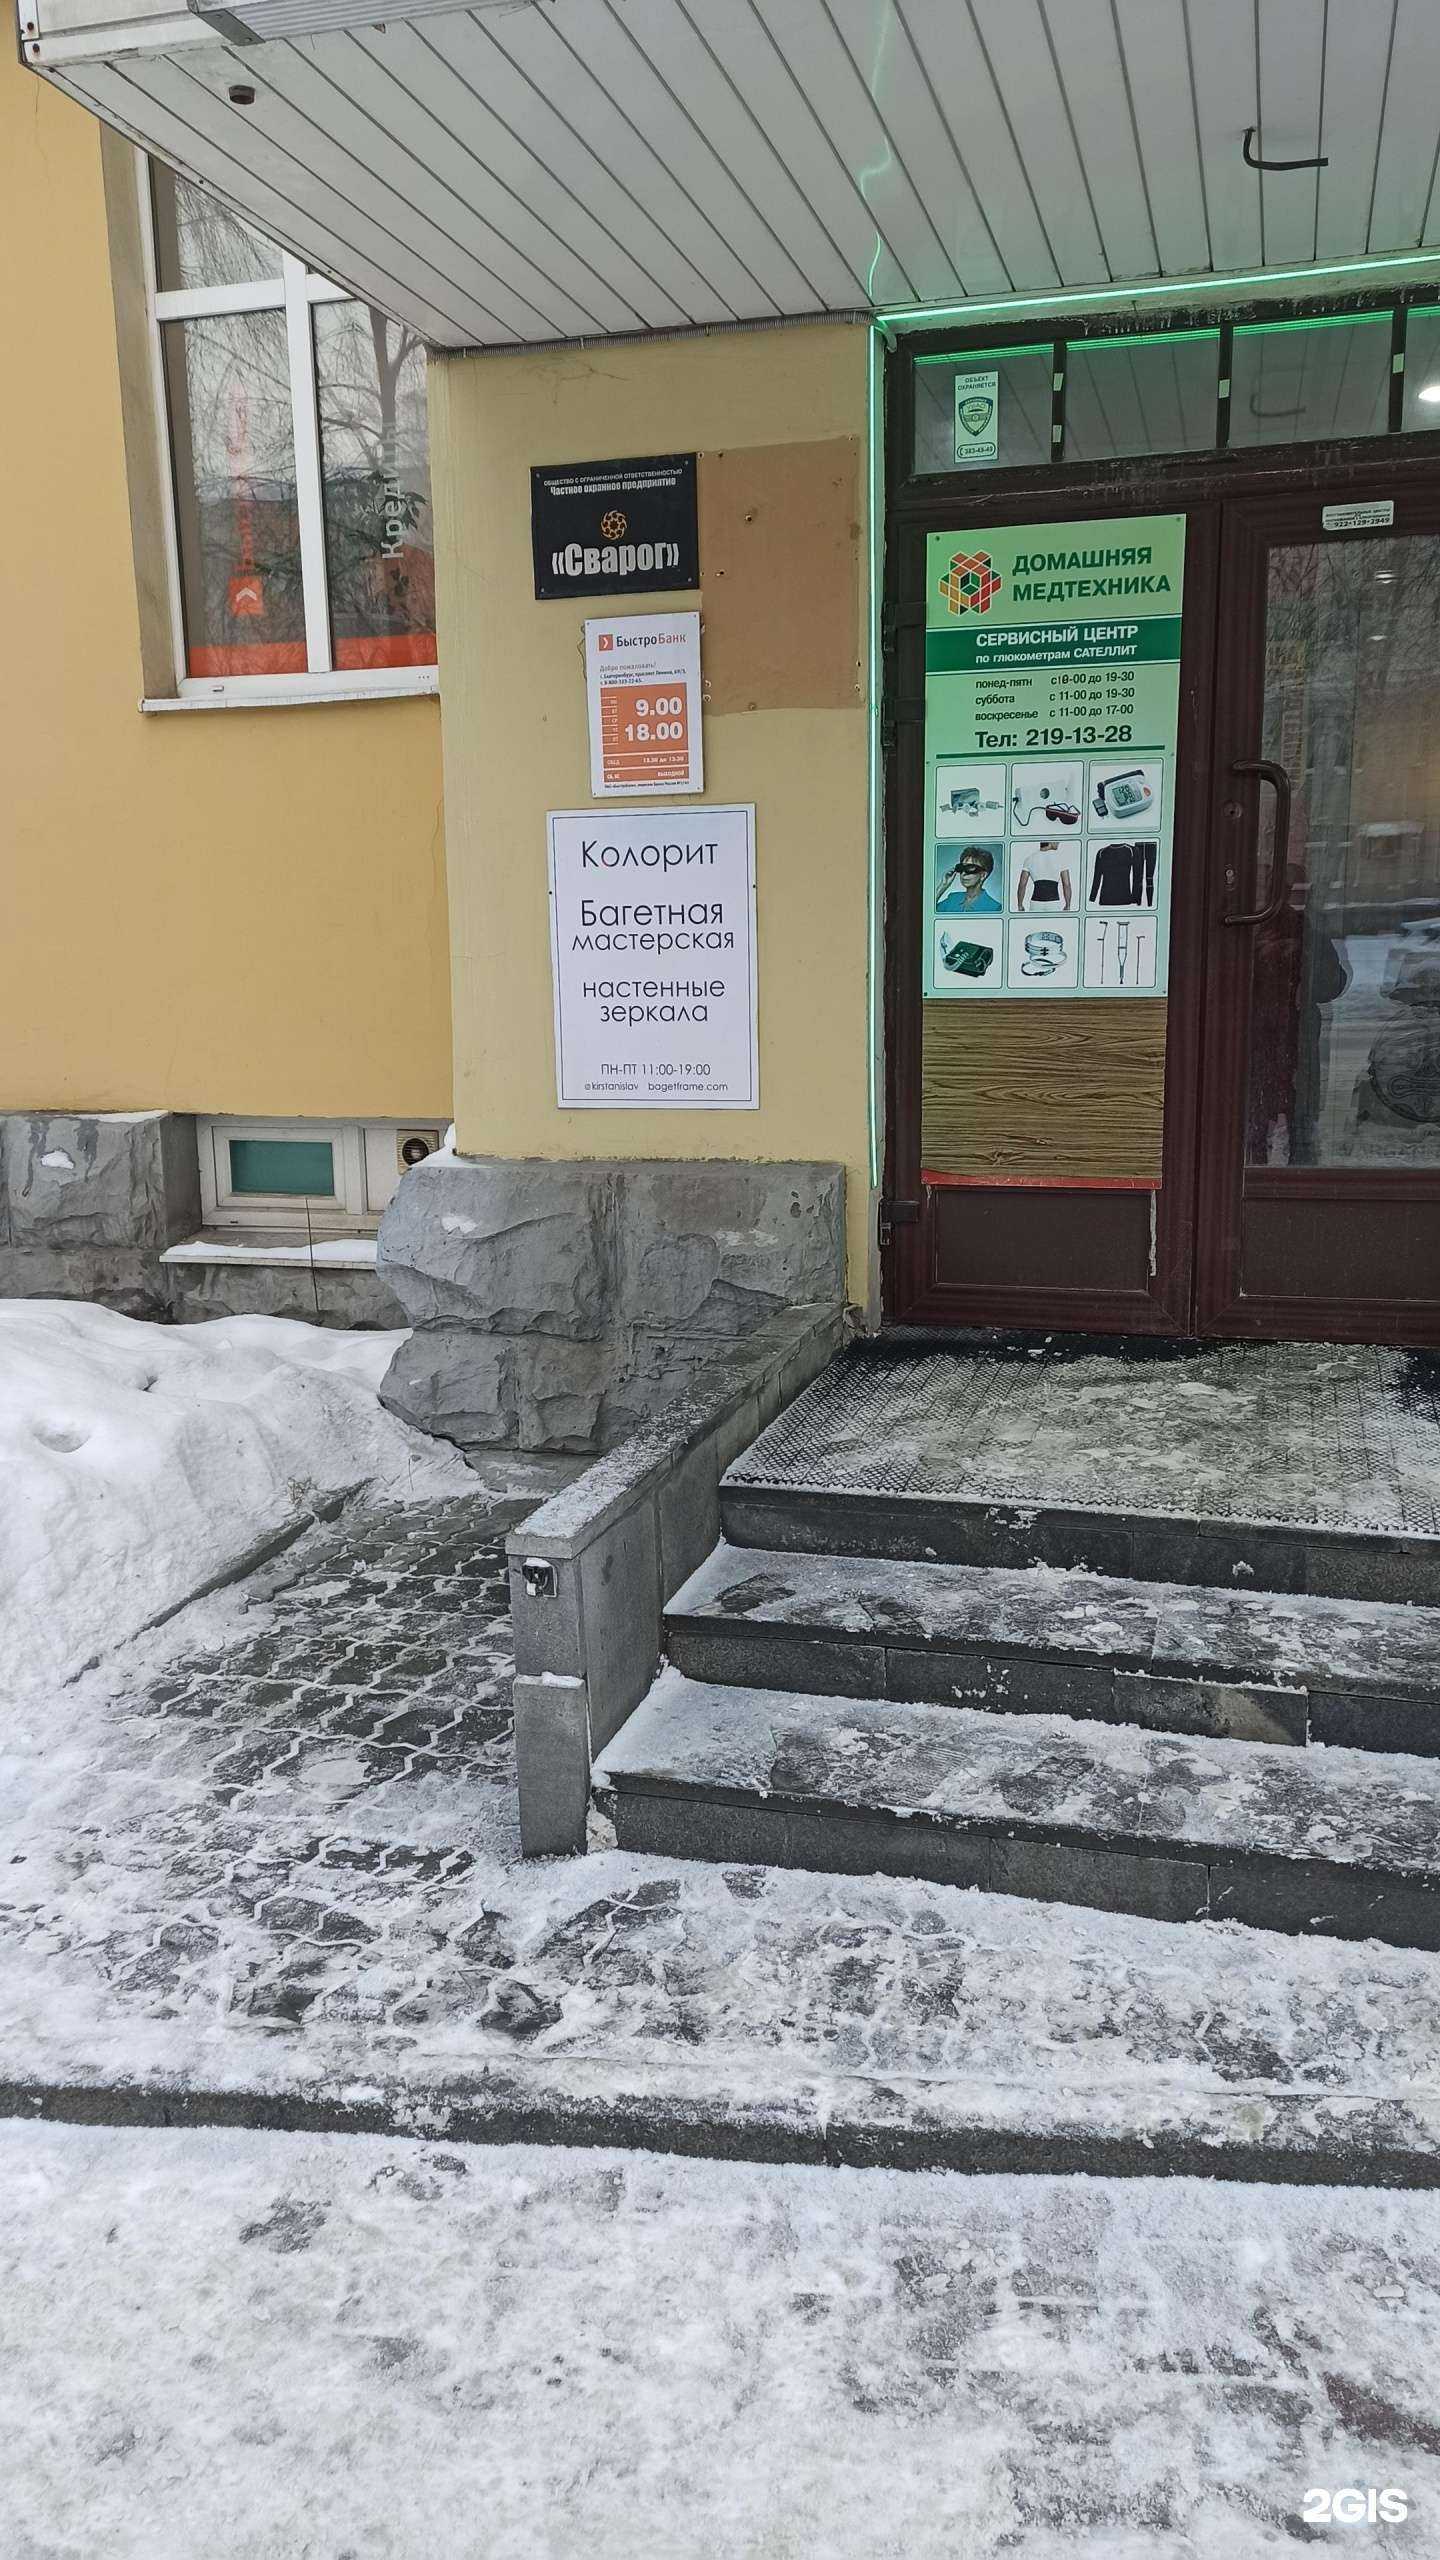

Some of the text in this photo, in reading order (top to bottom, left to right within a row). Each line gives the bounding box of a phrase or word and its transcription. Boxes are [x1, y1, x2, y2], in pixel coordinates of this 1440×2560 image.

[580, 474, 623, 483] ОГРАНИЧЕННОЙ
[624, 469, 682, 479] ОТВЕТСТВЕННОСТЬЮ
[551, 478, 676, 495] Частное охранное предприятие
[552, 542, 679, 576] «Сварог»
[1012, 547, 1152, 576] ДОМАШНЯЯ
[1013, 575, 1171, 602] МЕДТЕХНИКА
[617, 633, 687, 648] БыстроБанк
[976, 625, 1138, 647] СЕРВИСНЫЙ ЦЕНТР
[976, 645, 1137, 664] по глюкометрам САТЕЛЛИТ
[976, 678, 1032, 688] понед-пятн
[1088, 674, 1102, 683] до
[1105, 671, 1135, 682] 19-30
[635, 697, 682, 716] 9.00
[975, 688, 1135, 706] суббота с 11-00 до 19-30
[975, 710, 1038, 722] воскресенье
[1060, 706, 1087, 717] 11-00
[1088, 708, 1102, 717] до
[1106, 704, 1134, 715] 17-00
[625, 722, 683, 741] 18.00
[975, 725, 1132, 748] Тел: 219-13-28
[582, 840, 718, 872] Колорит
[581, 900, 723, 926] Багетная
[572, 931, 734, 955] мастерская
[583, 980, 725, 998] настенные
[600, 1005, 708, 1027] зеркала
[601, 1063, 711, 1076] ПН-ПТ 11:00-19:00
[584, 1082, 728, 1092] @kirstanislav bagetframe.com
